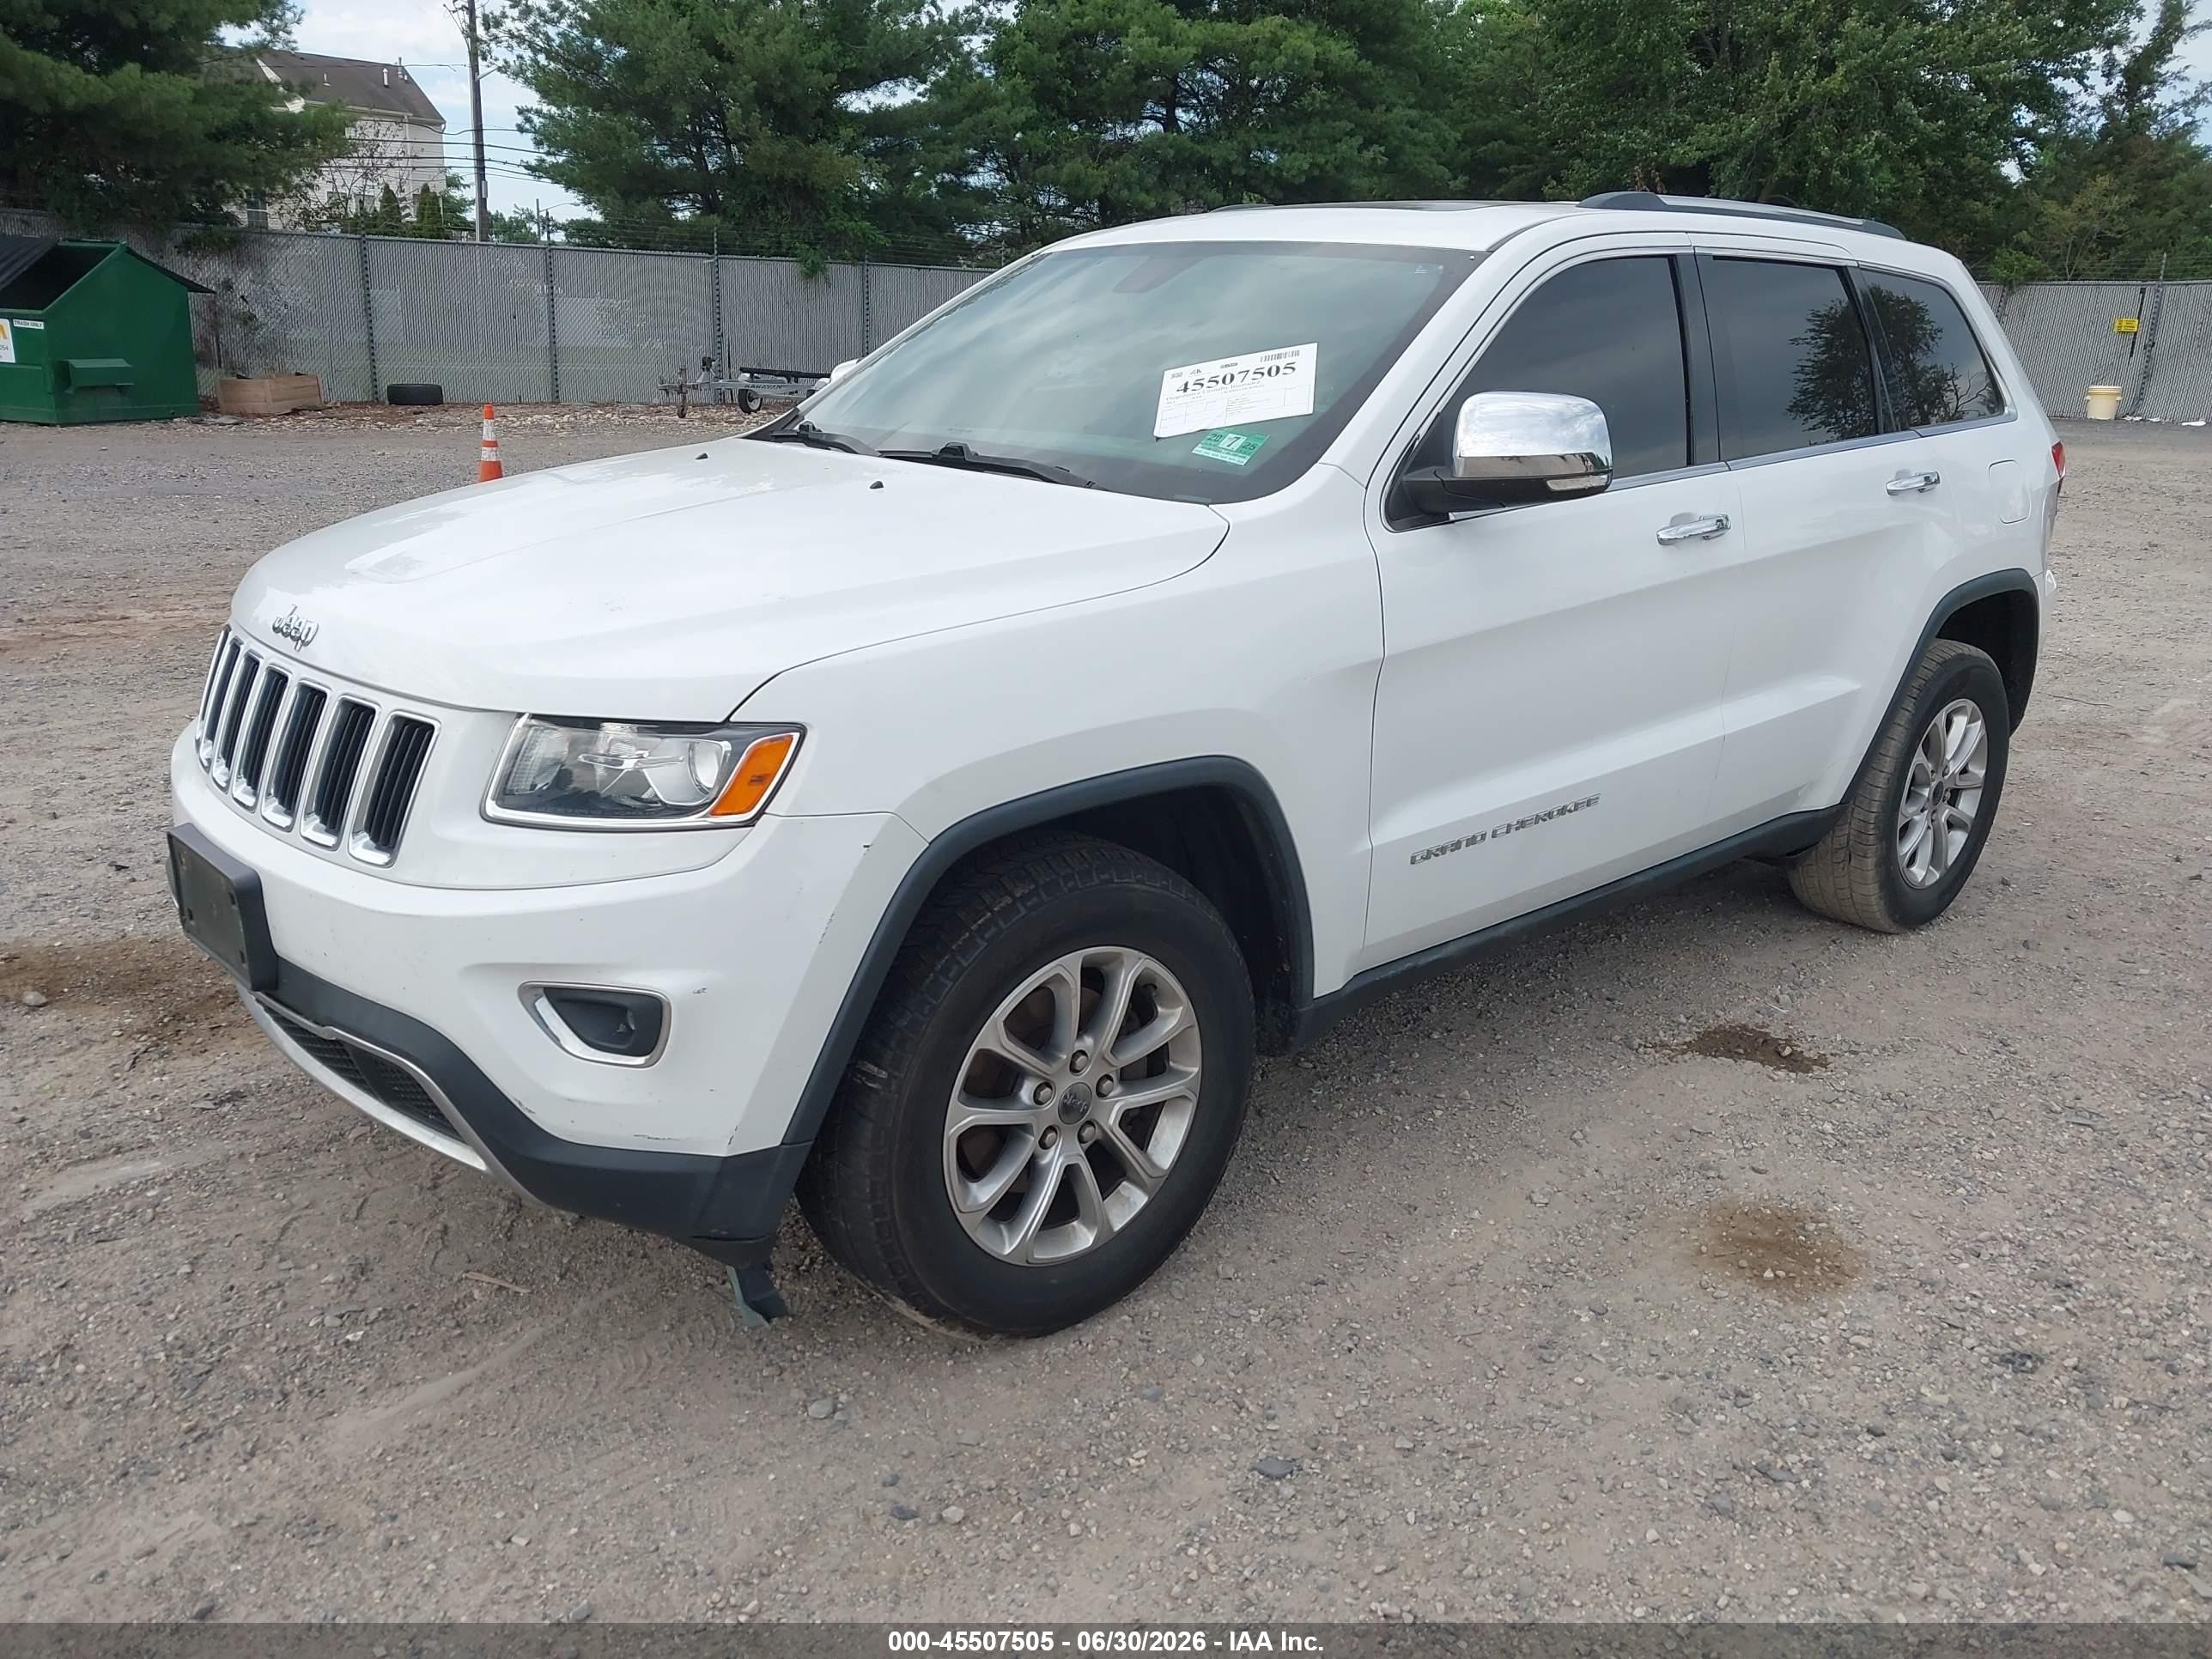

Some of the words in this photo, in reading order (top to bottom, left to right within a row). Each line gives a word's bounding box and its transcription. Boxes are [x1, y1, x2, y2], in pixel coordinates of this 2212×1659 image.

[1176, 361, 1297, 393] 45507505
[1211, 433, 1224, 442] 20
[1226, 436, 1242, 448] 7
[272, 604, 319, 653] Jeep
[1410, 830, 1487, 865] GRAND
[1492, 793, 1601, 839] CHEROKEE
[1064, 1091, 1088, 1113] Jeep
